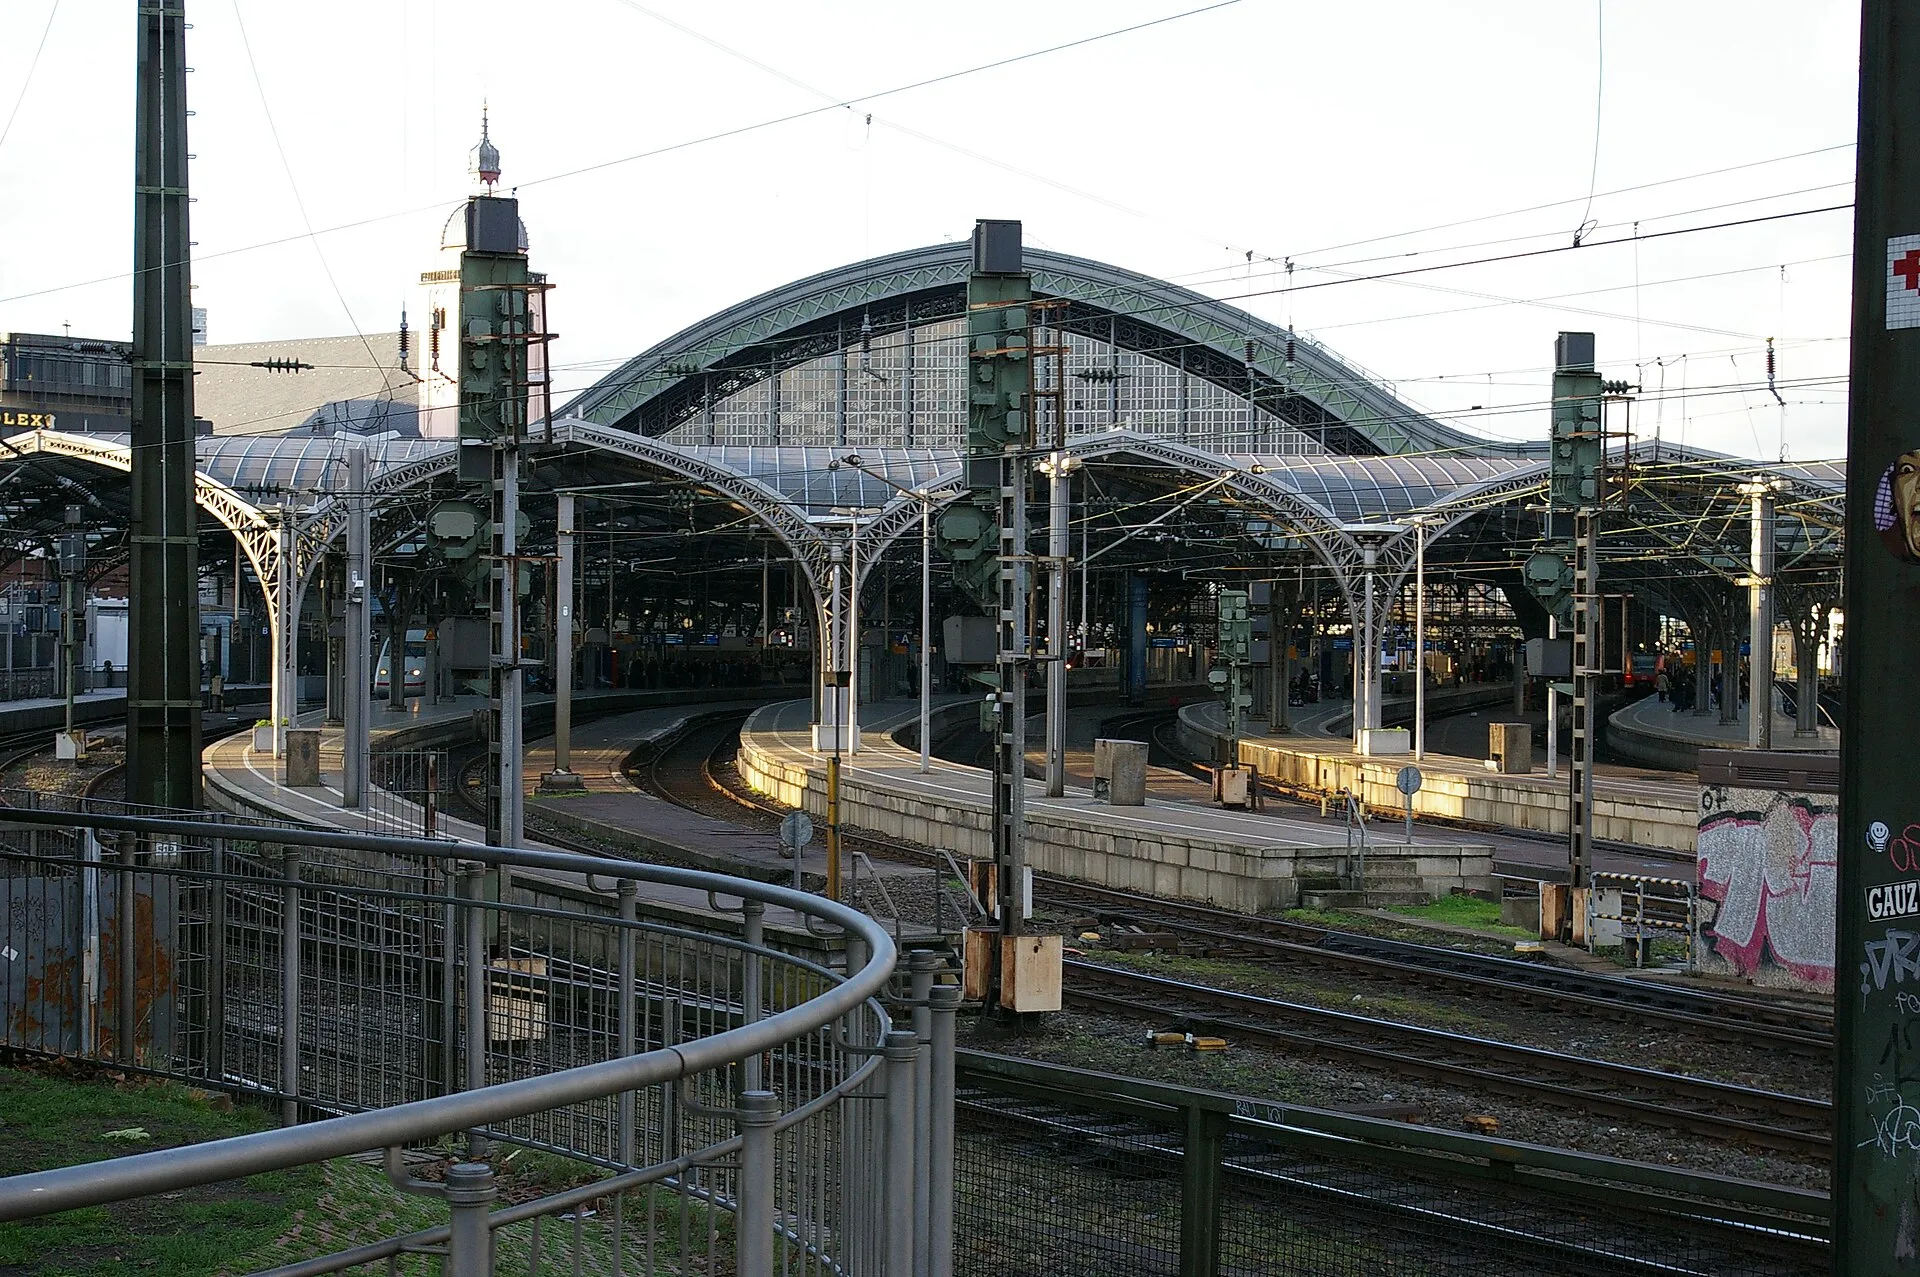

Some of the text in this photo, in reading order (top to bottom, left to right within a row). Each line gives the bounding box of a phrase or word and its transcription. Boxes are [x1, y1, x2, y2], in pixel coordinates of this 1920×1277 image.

[0, 412, 43, 427] LEX
[262, 626, 269, 635] B
[901, 634, 910, 644] A
[1868, 882, 1919, 918] GAUZ
